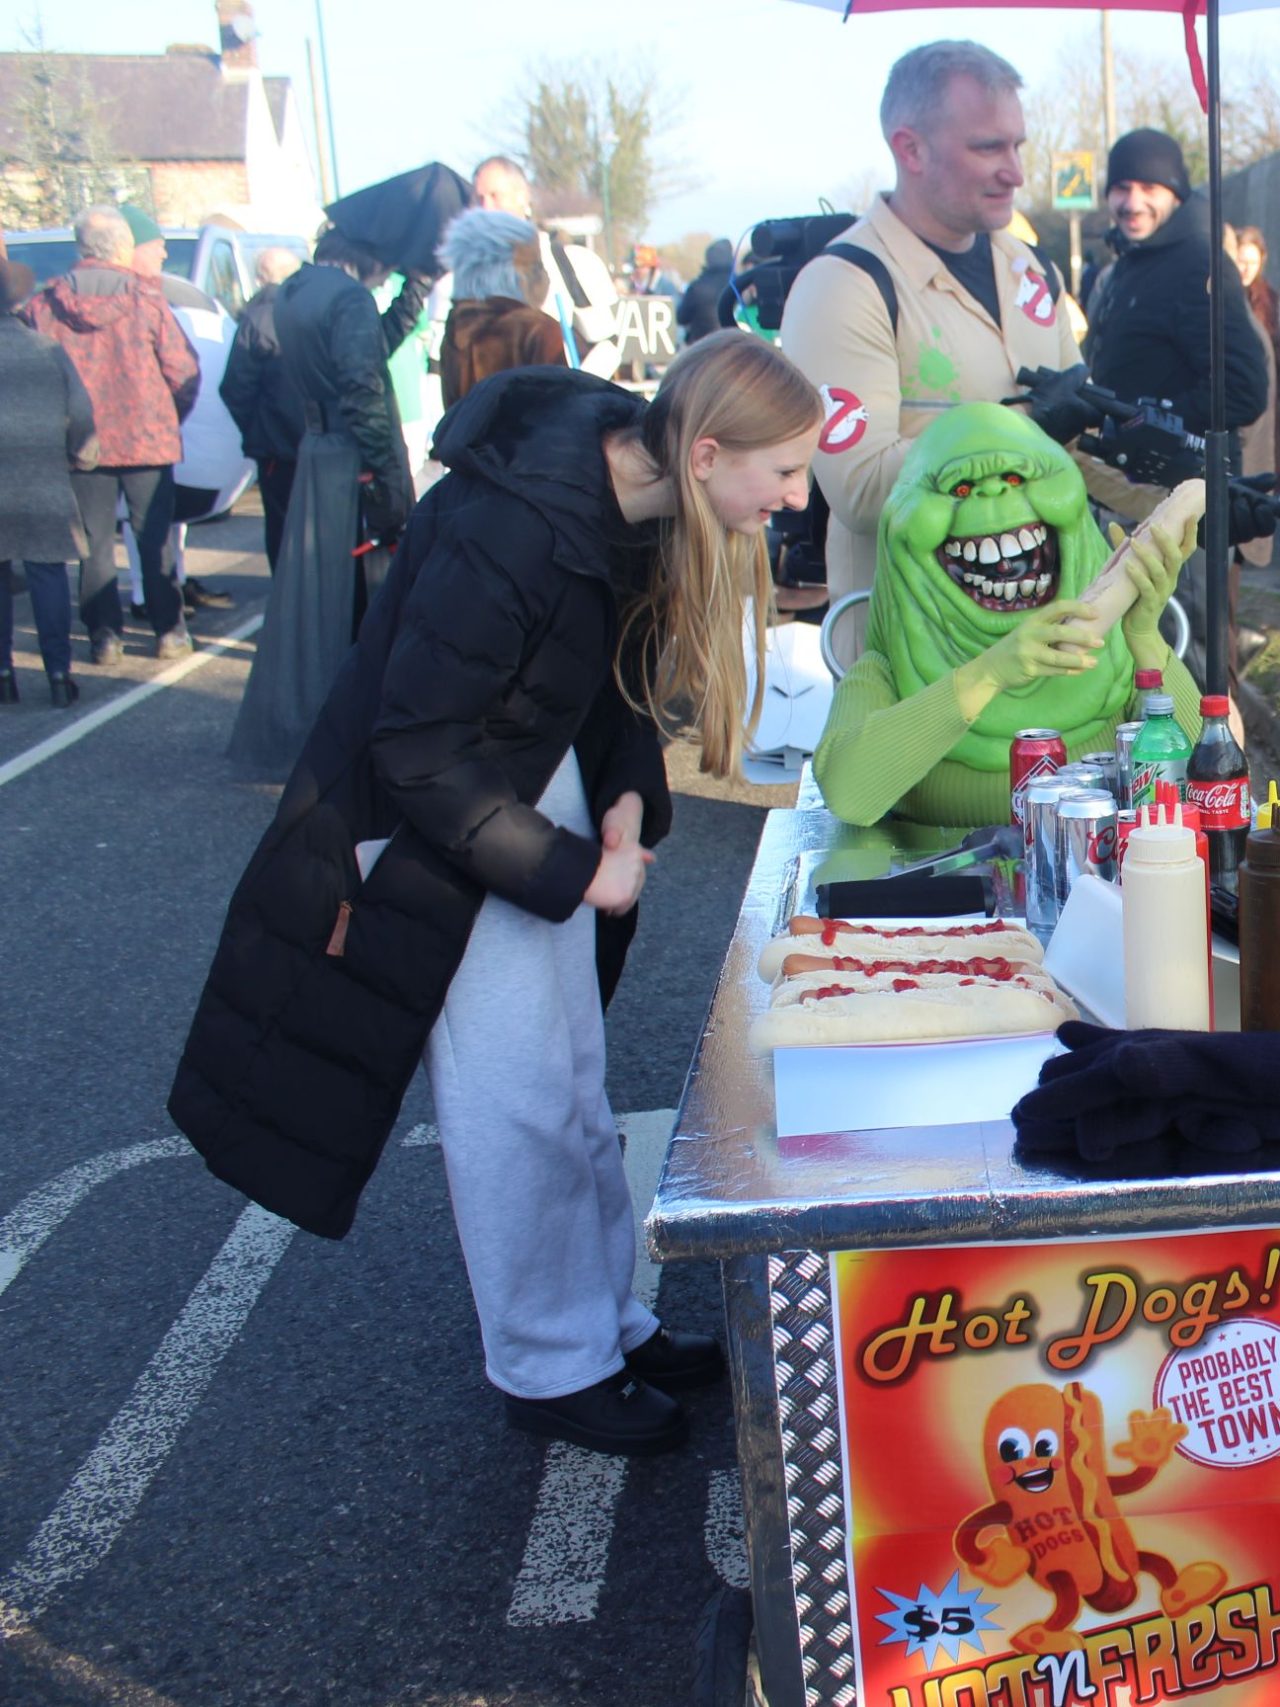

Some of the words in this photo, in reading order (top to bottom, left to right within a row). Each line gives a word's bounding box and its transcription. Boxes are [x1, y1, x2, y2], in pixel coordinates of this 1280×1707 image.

[1186, 782, 1239, 808] Coca-Cola
[861, 1293, 1031, 1381] Hot
[1178, 1336, 1277, 1385] PROBABLY
[1168, 1393, 1212, 1423] THE
[1219, 1370, 1276, 1412] BEST
[1014, 1506, 1073, 1543] HOT
[1033, 1529, 1085, 1560] DOGS
[902, 1604, 977, 1642] $5
